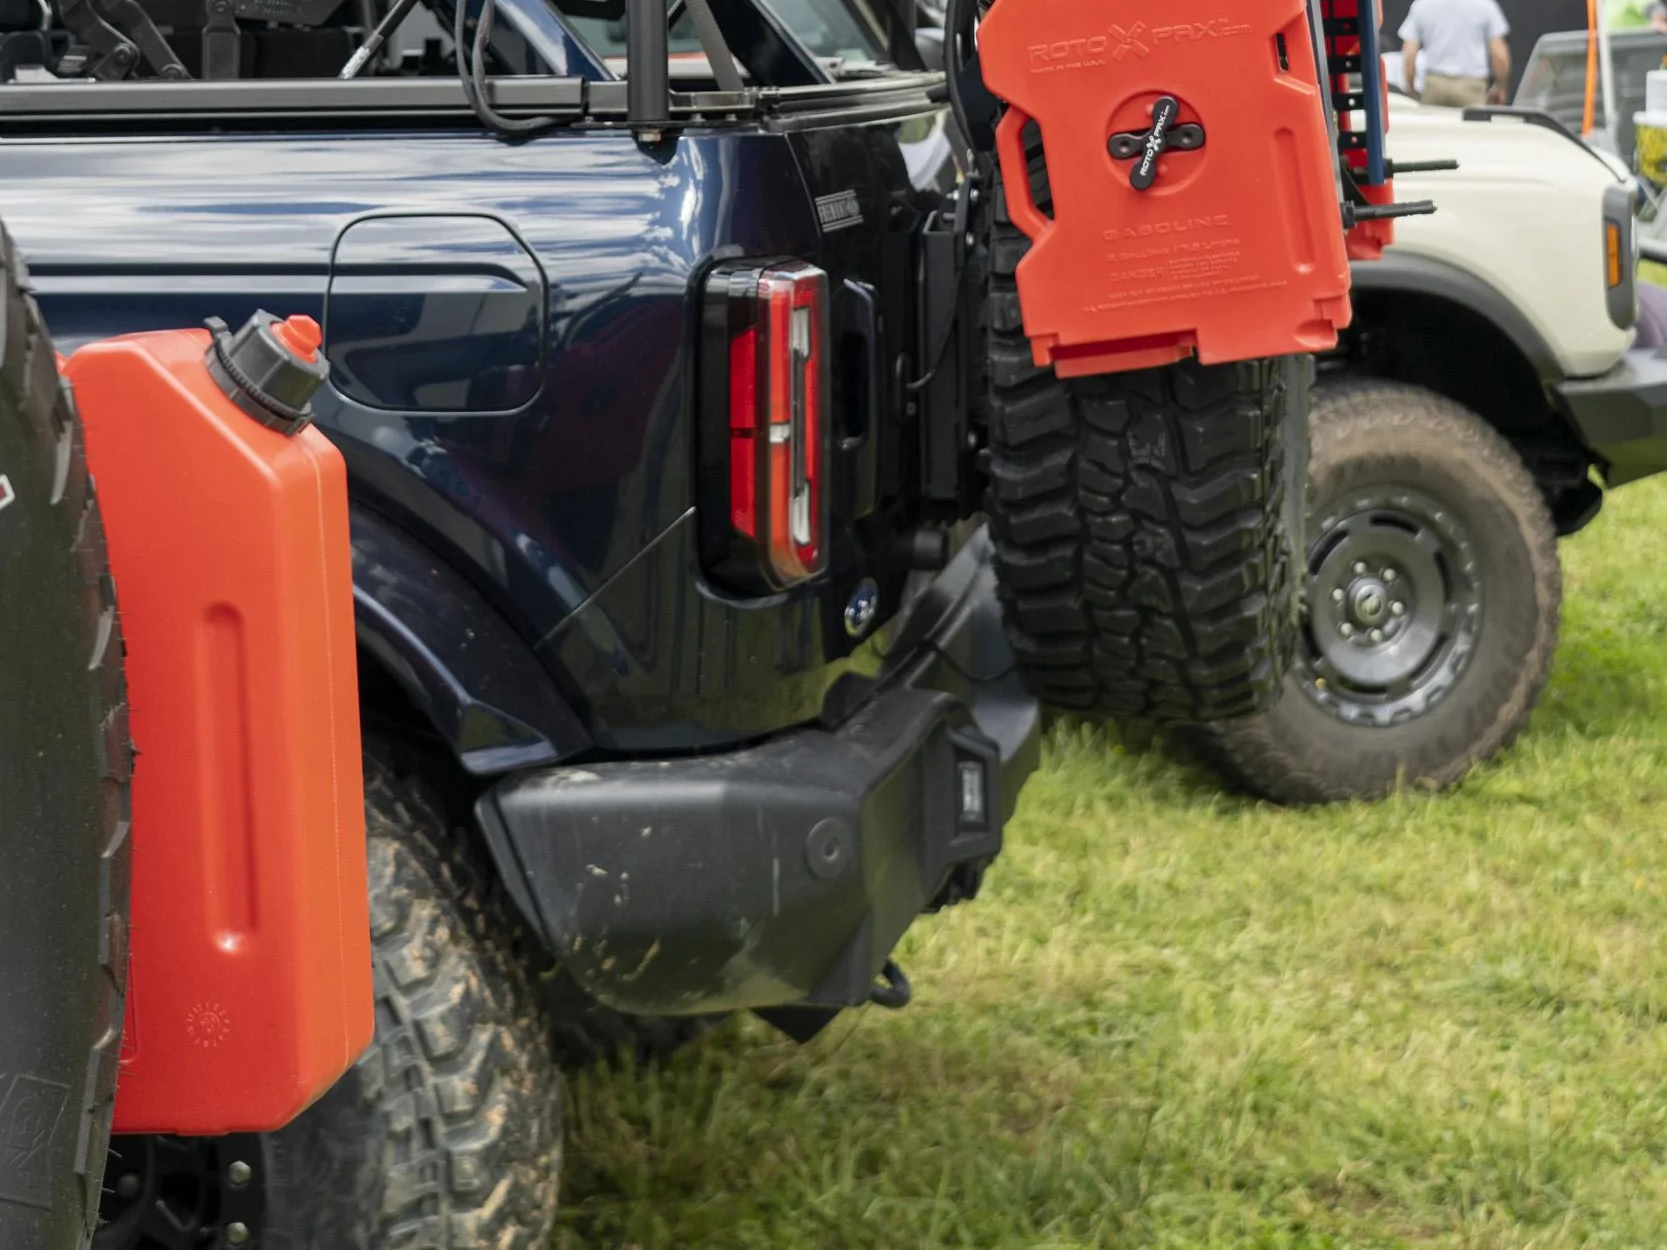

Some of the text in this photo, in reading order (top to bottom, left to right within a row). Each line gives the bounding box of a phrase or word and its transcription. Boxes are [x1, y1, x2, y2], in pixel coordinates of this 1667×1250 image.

[1027, 35, 1107, 62] ROTO
[1140, 149, 1154, 176] ROTO
[1102, 214, 1230, 240] GASOLINE
